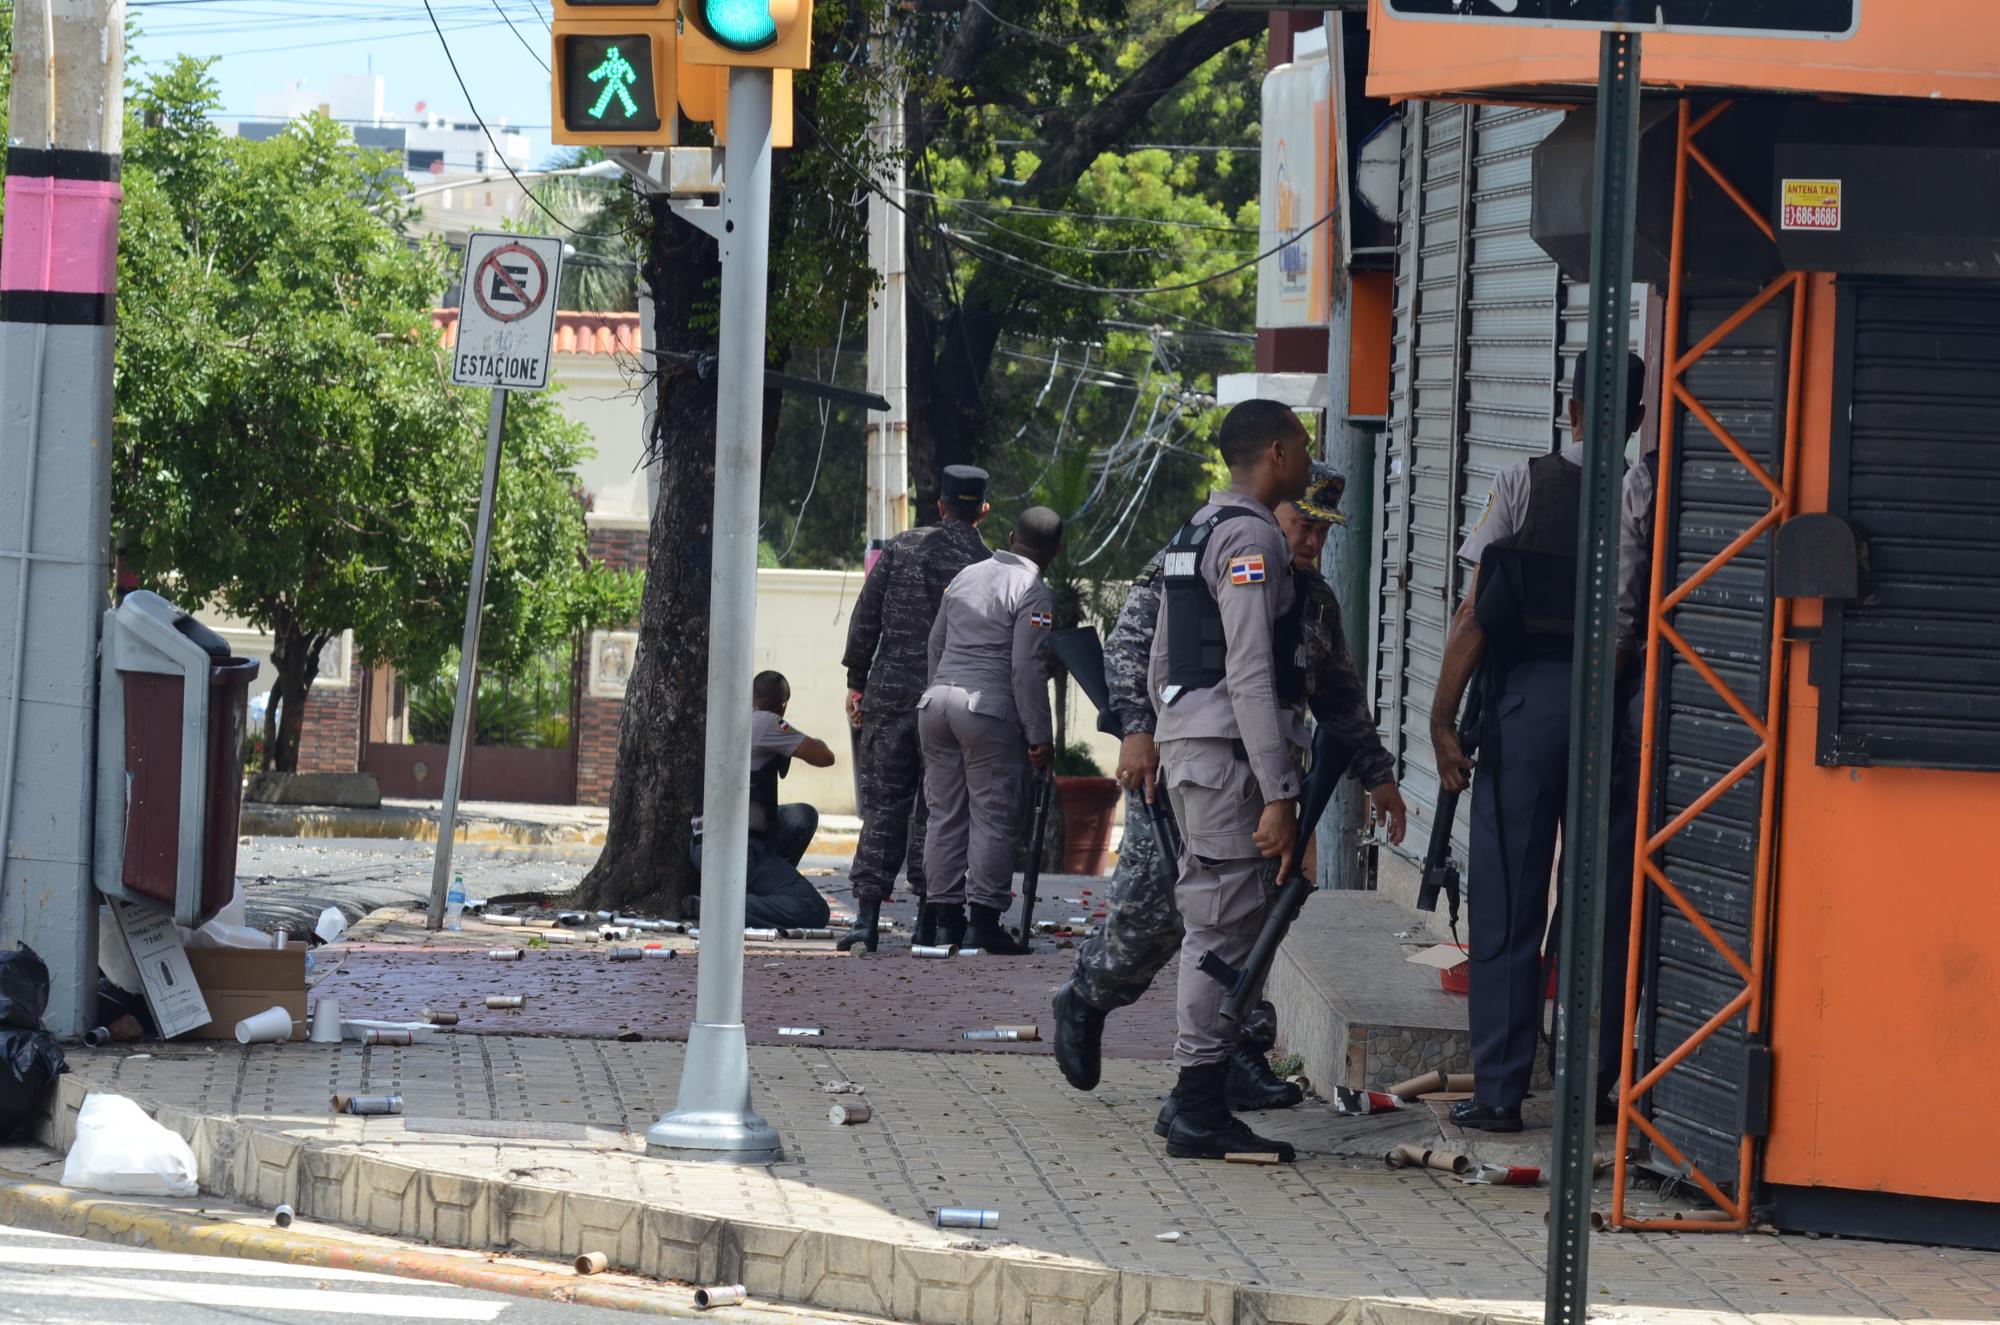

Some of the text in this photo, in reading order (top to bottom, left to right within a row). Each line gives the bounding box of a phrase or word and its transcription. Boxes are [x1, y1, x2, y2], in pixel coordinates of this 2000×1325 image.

[1787, 184, 1837, 196] ANTENA TAXI
[1796, 206, 1837, 226] 686-8686
[459, 354, 539, 380] ESTACIONE
[143, 932, 164, 946] 7105
